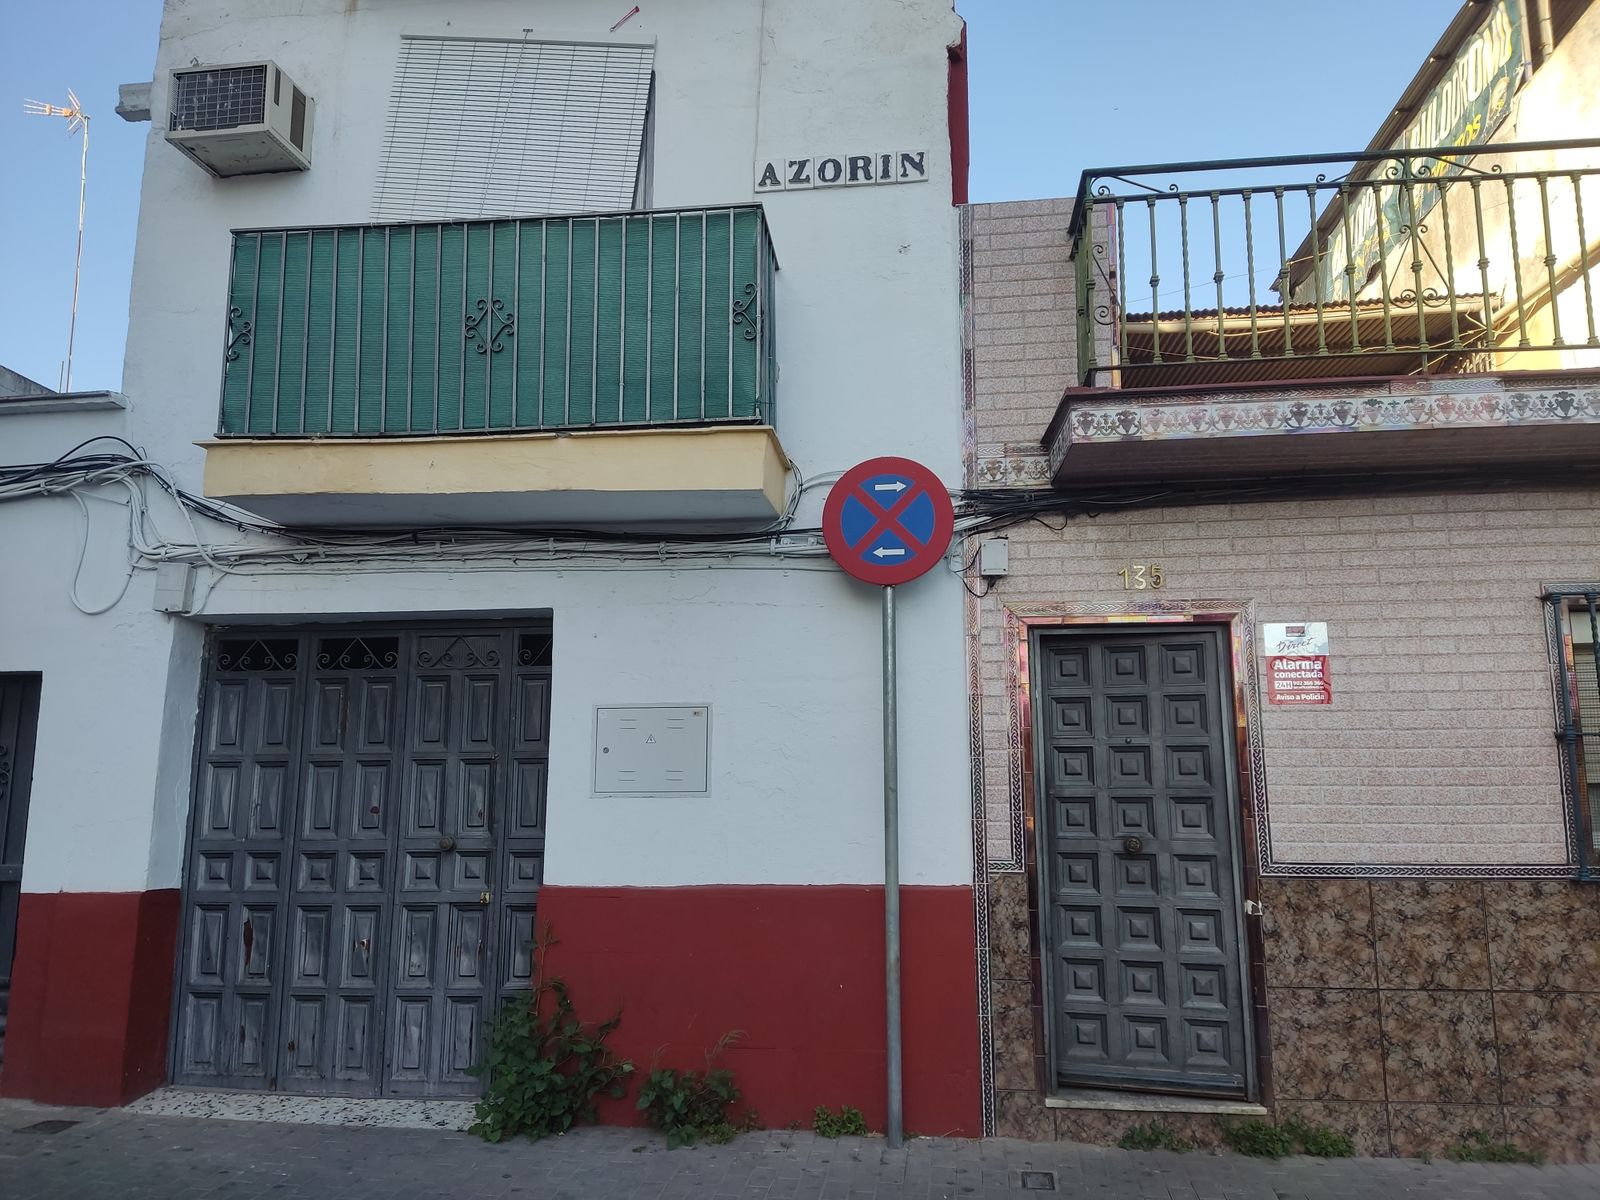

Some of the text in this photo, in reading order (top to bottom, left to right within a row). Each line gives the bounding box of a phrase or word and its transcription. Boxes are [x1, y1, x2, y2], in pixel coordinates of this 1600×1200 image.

[758, 151, 925, 187] AZORIN
[1118, 564, 1163, 590] 135
[1276, 637, 1314, 653] Direct
[1274, 659, 1322, 670] Alarma
[1274, 669, 1323, 679] conectada
[1276, 681, 1292, 689] 24H
